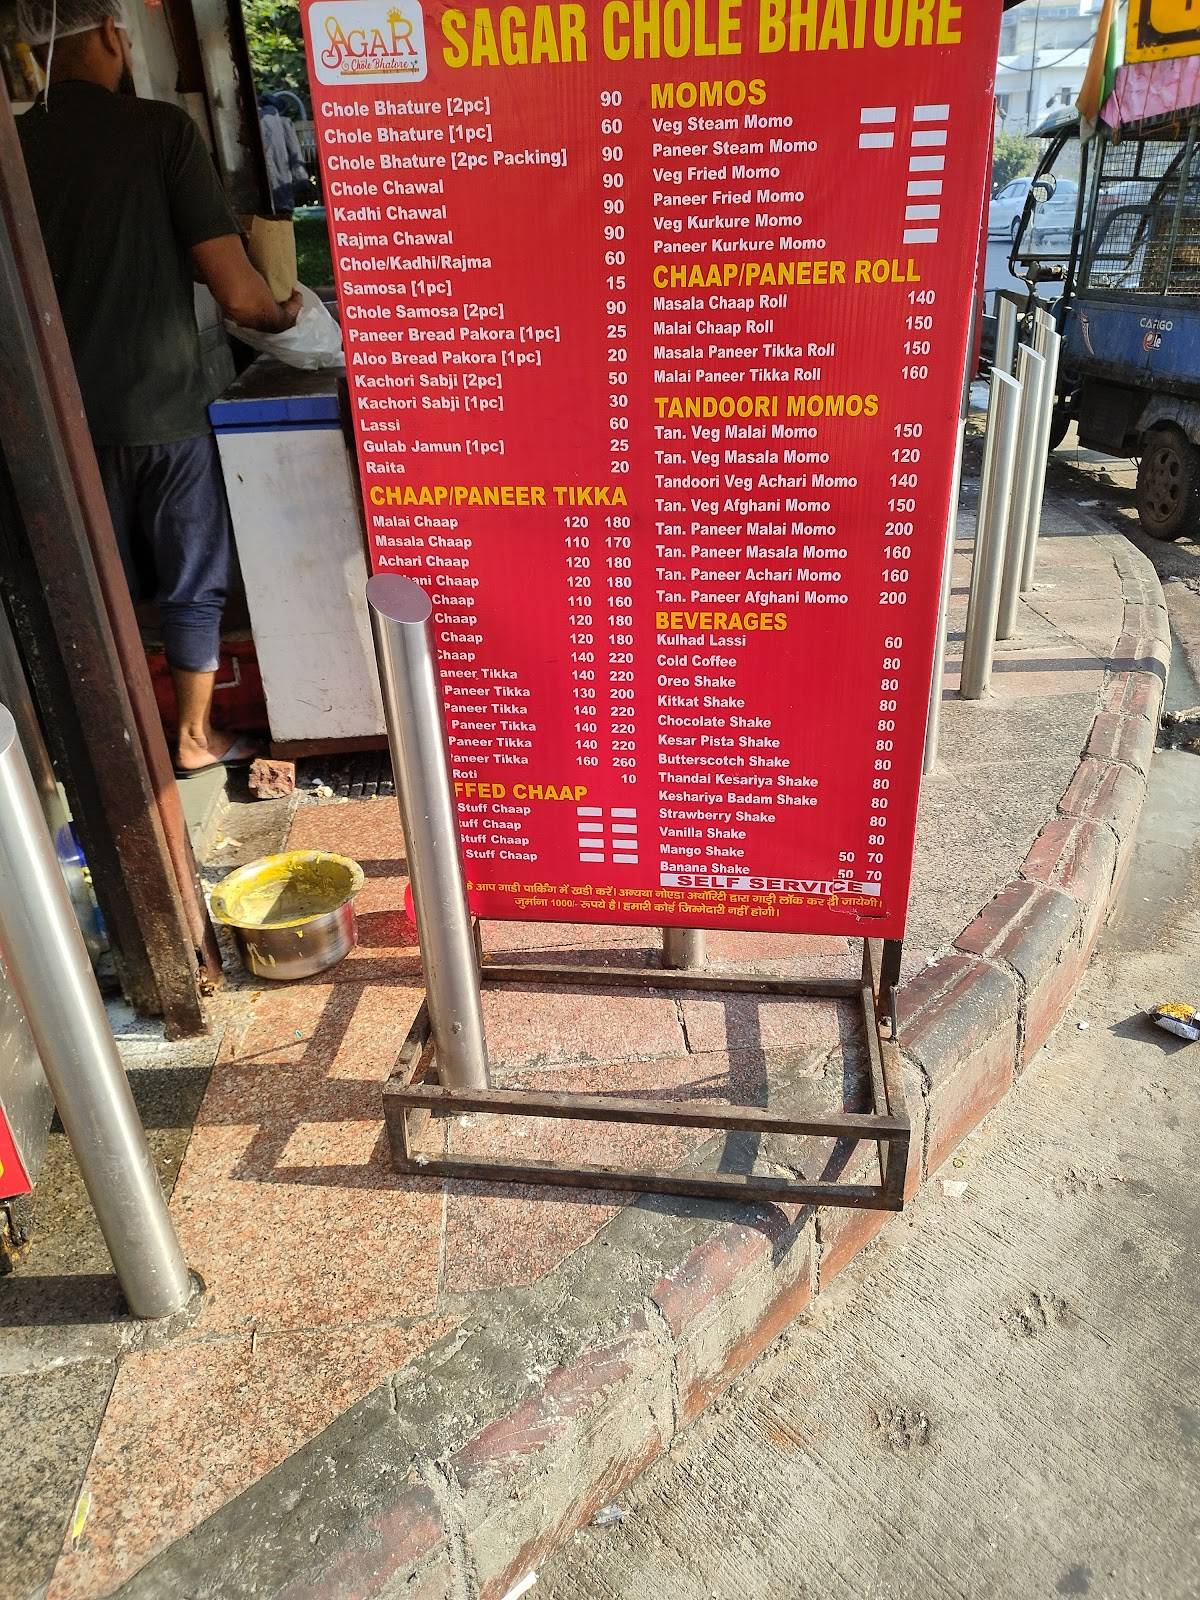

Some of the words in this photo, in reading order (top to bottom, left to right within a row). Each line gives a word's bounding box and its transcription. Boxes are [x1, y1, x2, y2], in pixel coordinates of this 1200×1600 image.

[441, 4, 588, 69] SAGAR
[602, 0, 742, 61] CHOLE
[758, 0, 962, 54] BHATURE
[351, 58, 371, 71] Chole
[651, 78, 767, 109] MOMOS
[321, 101, 370, 118] Chole
[374, 99, 442, 116] Bhature
[446, 95, 491, 117] [2pc]
[600, 90, 622, 107] 90
[652, 117, 683, 136] Veg
[687, 116, 739, 132] Steam
[744, 113, 793, 129] Momo
[652, 143, 709, 157] Paneer
[712, 140, 764, 156] Steam
[769, 138, 818, 153] Momo
[327, 155, 376, 171] Chole
[379, 153, 447, 169] Bhature
[450, 151, 488, 171] [2pc
[493, 148, 568, 168] Packing]
[601, 146, 624, 162] 90
[652, 167, 683, 185] Veg
[687, 165, 727, 181] Fried
[731, 164, 780, 180] Momo
[330, 181, 378, 197] Chole
[382, 178, 444, 195] Chawal
[602, 172, 624, 189] 90
[333, 206, 382, 222] Kadhi
[386, 204, 447, 221] Chawal
[603, 199, 625, 215] 90
[652, 216, 683, 233] Veg
[687, 214, 750, 230] Kurkure
[755, 213, 803, 227] Momo
[339, 254, 492, 273] Chole/Kadhi/Rajma
[604, 250, 626, 266] 60
[653, 260, 846, 289] CHAAP/PANEER
[854, 258, 921, 284] ROLL
[342, 281, 407, 296] Samosa
[410, 279, 452, 298] [1pc]
[606, 275, 626, 290] 15
[653, 295, 704, 311] Masala
[708, 295, 755, 313] Chaap
[759, 293, 788, 309] Roll
[907, 289, 936, 305] 140
[348, 328, 404, 343] Paneer
[408, 327, 456, 342] Bread
[459, 326, 515, 341] Pakora
[519, 325, 561, 343] [1pc]
[606, 324, 627, 339] 25
[653, 345, 704, 360] Masala
[708, 344, 759, 359] Paneer
[762, 343, 803, 358] Tikka
[807, 342, 835, 357] Roll
[903, 340, 931, 355] 150
[354, 374, 415, 388] Kachori
[419, 373, 458, 390] Sabji
[462, 373, 503, 390] [2pc]
[608, 371, 628, 385] 50
[654, 395, 778, 418] TANDOORI
[786, 394, 879, 417] MOMOS
[360, 418, 401, 432] Lassi
[609, 416, 629, 430] 60
[653, 425, 687, 440] Tan.
[690, 424, 721, 443] Veg
[724, 424, 767, 439] Malai
[771, 424, 818, 439] Momo
[893, 423, 923, 438] 150
[363, 439, 407, 453] Gulab
[410, 439, 462, 453] Jamun
[465, 439, 505, 456] [1pc]
[610, 438, 630, 452] 25
[365, 461, 406, 474] Raita
[610, 460, 630, 474] 20
[654, 474, 720, 489] Tandoori
[724, 474, 753, 492] Veg
[757, 473, 807, 488] Achari
[811, 473, 858, 488] Momo
[889, 473, 918, 488] 140
[369, 485, 547, 506] CHAAP/PANEER
[552, 486, 628, 506] TIKKA
[372, 515, 411, 528] Malai
[413, 515, 459, 531] Chaap
[563, 516, 589, 528] 120
[604, 516, 631, 529] 180
[375, 534, 425, 547] Masala
[427, 535, 473, 550] Chaap
[564, 536, 590, 548] 110
[605, 536, 632, 549] 170
[378, 554, 422, 567] Achari
[425, 555, 470, 570] Chaap
[565, 556, 591, 569] 120
[605, 556, 632, 569] 180
[655, 589, 687, 603] Tan.
[690, 590, 741, 603] Paneer
[744, 590, 800, 607] Afghani
[804, 590, 849, 604] Momo
[879, 591, 907, 605] 200
[655, 611, 788, 631] BEVERAGES
[656, 633, 705, 646] Kulhad
[709, 634, 746, 647] Lassi
[884, 636, 903, 649] 60
[656, 654, 688, 667] Cold
[691, 654, 737, 668] Coffee
[882, 657, 901, 670] 80
[439, 669, 478, 679] aneer
[480, 668, 518, 680] Tikka
[571, 669, 595, 681] 140
[609, 670, 635, 682] 220
[444, 684, 491, 696] Paneer
[493, 685, 531, 697] Tikka
[572, 687, 596, 699] 130
[609, 688, 635, 700] 200
[657, 694, 699, 708] Kitkat
[703, 695, 745, 708] Shake
[879, 699, 897, 712] 80
[657, 714, 726, 728] Chocolate
[729, 715, 772, 729] Shake
[877, 719, 896, 732] 80
[452, 768, 478, 779] Roti
[621, 773, 637, 784] 10
[658, 771, 711, 784] Thandai
[715, 773, 773, 789] Kesariya
[776, 774, 819, 788] Shake
[872, 778, 890, 790] 80
[454, 782, 506, 799] FFED
[512, 783, 588, 801] CHAAP
[457, 802, 488, 813] Stuff
[491, 803, 531, 816] Chaap
[660, 860, 708, 873] Banana
[711, 862, 751, 875] Shake
[837, 868, 854, 879] 50
[866, 870, 883, 881] 70
[676, 875, 740, 889] SELF
[748, 878, 864, 894] SERVICE
[559, 884, 570, 894] में
[806, 897, 825, 906] कर
